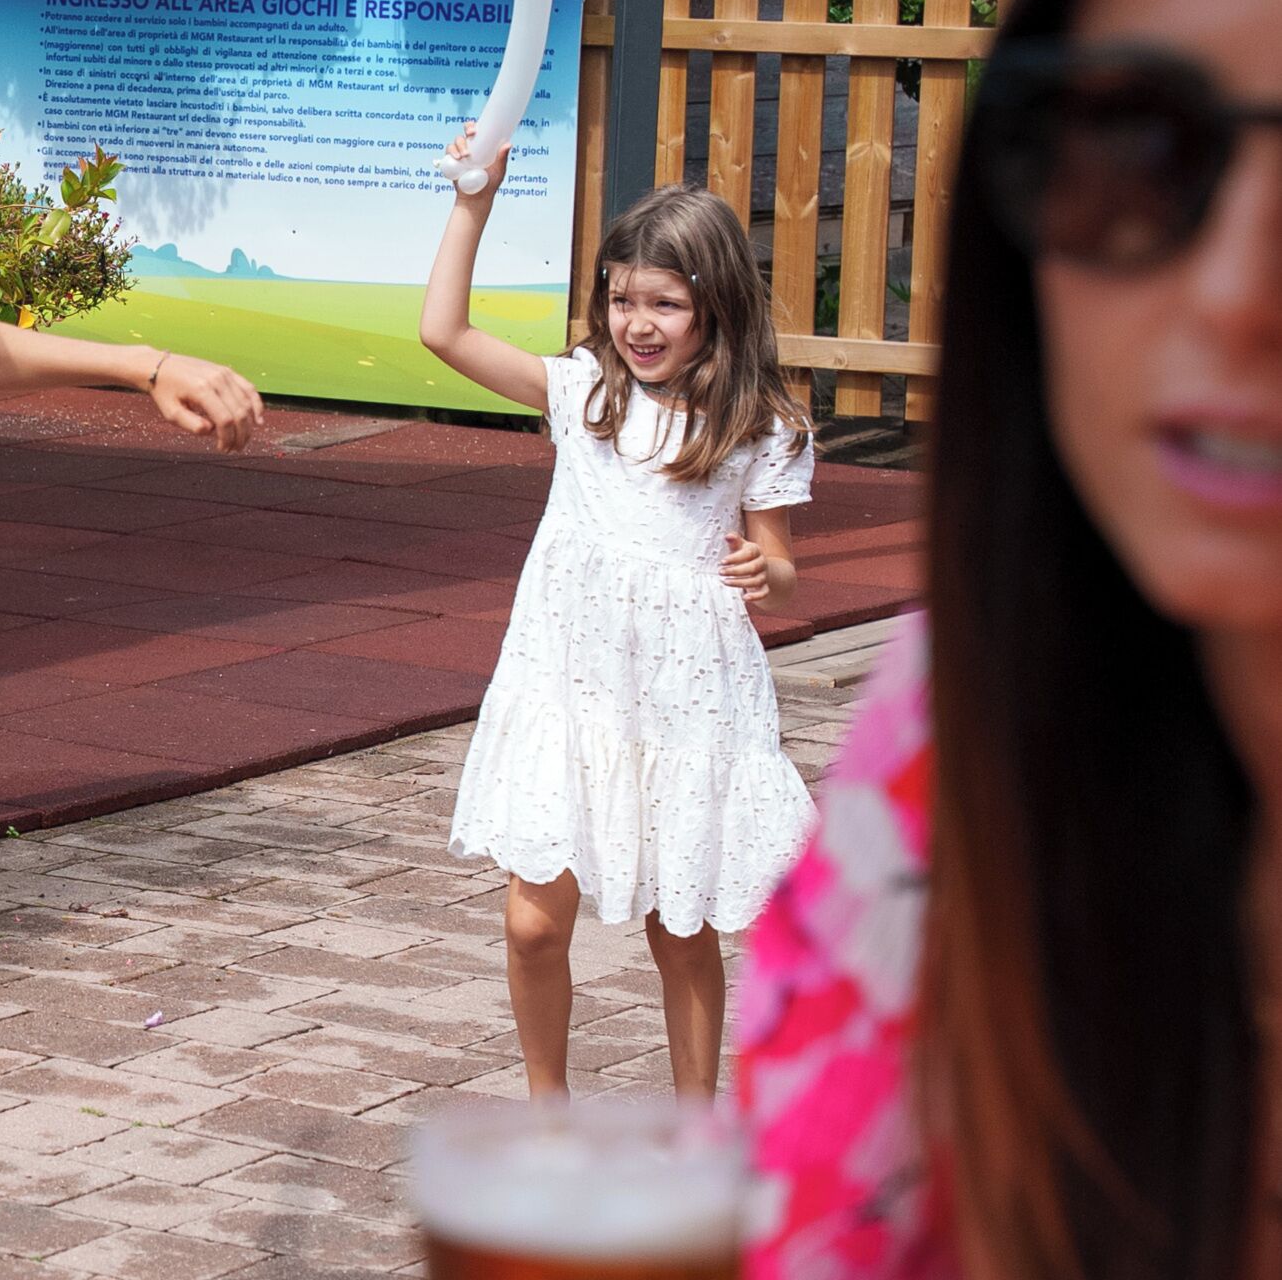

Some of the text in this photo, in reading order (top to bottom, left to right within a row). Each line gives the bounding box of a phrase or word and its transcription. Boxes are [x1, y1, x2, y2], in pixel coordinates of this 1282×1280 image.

[345, 0, 356, 17] E
[365, 0, 512, 23] RESPONSABIL
[44, 25, 87, 36] All'interno
[138, 29, 178, 41] proprietà
[190, 31, 214, 41] MGM
[216, 32, 263, 43] Restaurant
[265, 34, 276, 43] srl
[288, 35, 348, 48] responsabilità
[351, 38, 364, 47] dei
[367, 38, 401, 48] bambini
[412, 40, 426, 49] del
[428, 41, 467, 53] genitore
[44, 41, 103, 51] (maggiorenne)
[126, 44, 145, 54] tutti
[148, 45, 159, 56] gli
[164, 46, 198, 58] obblighi
[214, 48, 252, 60] vigilanza
[272, 50, 317, 60] attenzione
[388, 55, 450, 68] responsabilità
[454, 57, 488, 67] relative
[46, 52, 80, 62] infortuni
[83, 54, 106, 63] subiti
[108, 55, 121, 64] dal
[123, 56, 152, 65] minore
[162, 57, 183, 67] dallo
[185, 58, 212, 68] stesso
[214, 59, 255, 72] provocati
[270, 62, 287, 71] altri
[290, 63, 318, 72] minori
[319, 64, 334, 73] e/o
[344, 65, 364, 74] terzi
[45, 79, 84, 89] Direzione
[93, 84, 114, 93] pena
[176, 85, 200, 97] prima
[203, 86, 245, 97] dell'uscita
[247, 88, 260, 98] dal
[88, 69, 116, 79] sinistri
[252, 76, 292, 88] proprietà
[308, 79, 332, 88] MGM
[337, 80, 383, 90] Restaurant
[388, 82, 399, 91] srl
[403, 83, 445, 93] dovranno
[534, 88, 550, 98] alla
[50, 94, 110, 105] assolutamente
[114, 97, 143, 107] vietato
[146, 98, 177, 108] lasciare
[180, 100, 224, 111] incustoditi
[272, 105, 293, 114] salvo
[296, 106, 332, 116] delibera
[335, 108, 362, 118] scritta
[365, 109, 414, 120] concordata
[64, 107, 102, 117] contrario
[104, 109, 128, 118] MGM
[131, 110, 176, 121] Restaurant
[178, 112, 189, 121] srl
[190, 113, 220, 123] declina
[223, 114, 241, 126] ogni
[44, 132, 64, 142] dove
[98, 135, 123, 147] grado
[136, 137, 174, 148] muoversi
[186, 140, 220, 150] maniera
[46, 120, 79, 130] bambini
[98, 122, 112, 132] età
[114, 123, 150, 134] inferiore
[185, 127, 202, 136] anni
[205, 128, 236, 138] devono
[239, 132, 266, 140] essere
[269, 131, 313, 144] sorvegliati
[333, 135, 374, 147] maggiore
[406, 141, 443, 151] possono
[521, 145, 548, 157] giochi
[41, 146, 52, 155] Gli
[146, 152, 197, 165] responsabili
[199, 155, 212, 164] del
[215, 156, 253, 166] controllo
[264, 158, 284, 168] delle
[288, 160, 312, 170] azioni
[315, 161, 354, 174] compiute
[358, 164, 371, 173] dai
[415, 167, 430, 176] che
[508, 172, 547, 185] pertanto
[43, 171, 58, 181] dei
[152, 165, 166, 174] alla
[168, 166, 205, 177] struttura
[225, 169, 265, 180] materiale
[268, 171, 293, 181] ludico
[347, 178, 379, 188] sempre
[389, 178, 415, 188] carico
[418, 179, 431, 189] dei
